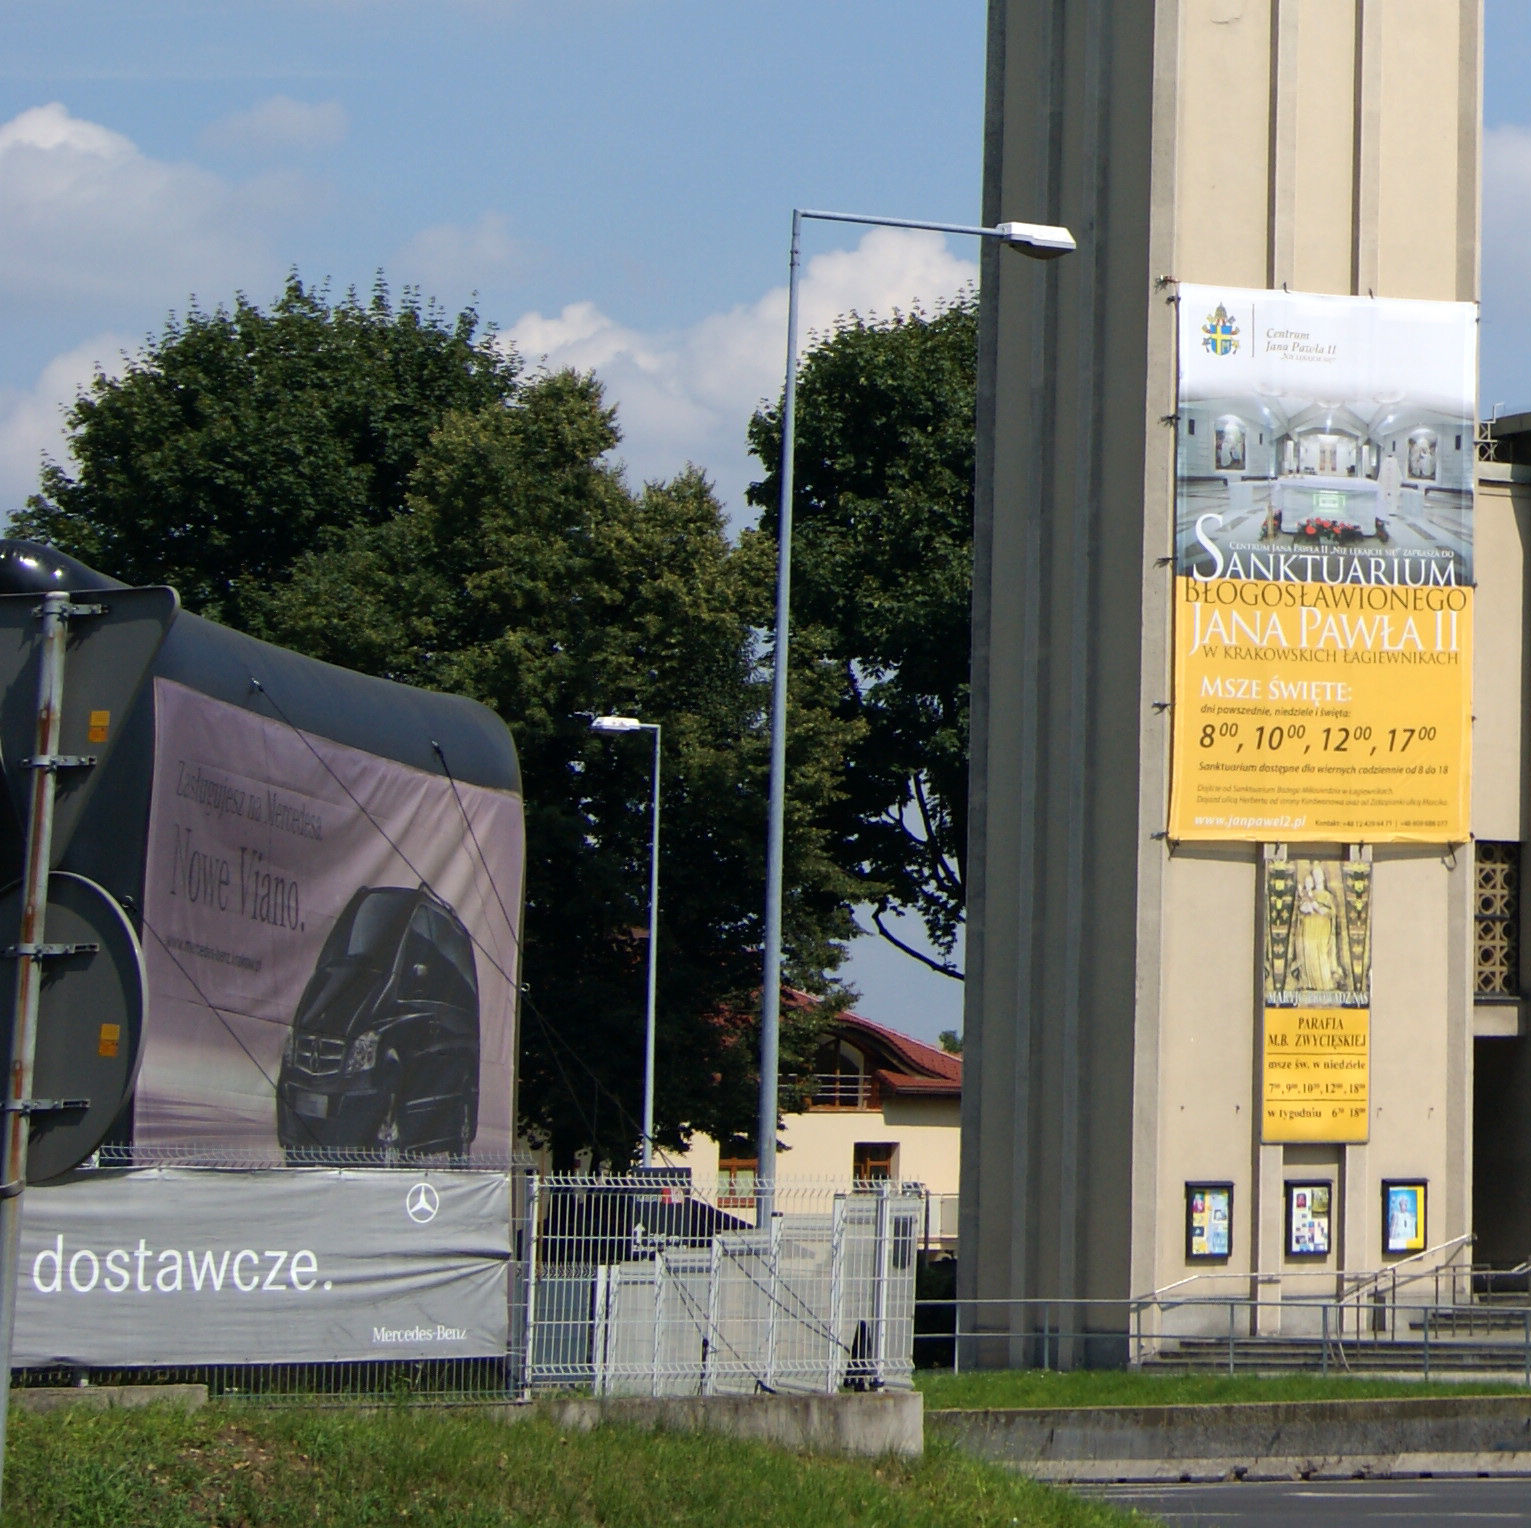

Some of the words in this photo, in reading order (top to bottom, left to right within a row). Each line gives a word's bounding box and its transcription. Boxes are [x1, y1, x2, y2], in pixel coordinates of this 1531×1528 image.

[1266, 327, 1310, 340] Centrum
[1265, 341, 1289, 352] Jana
[1192, 513, 1459, 588] SANKTUARIUM
[1184, 578, 1467, 612] BŁOGOSŁAWIONEGO
[1189, 602, 1289, 656] JANA
[1300, 606, 1423, 652] PAWŁA
[1434, 610, 1460, 652] II
[1203, 645, 1219, 658] W
[1224, 646, 1337, 663] KRAKOWSKICH
[1343, 649, 1459, 665] ŁAGIEWNIKACH
[1200, 674, 1262, 700] MSZE
[1268, 674, 1352, 708] ŚWIĘTE:
[1200, 704, 1216, 714] dni
[1217, 705, 1272, 717] powszednie,
[1274, 707, 1313, 717] niedziele
[1199, 761, 1257, 773] Sanktuarium
[1258, 763, 1300, 775] dostępne
[1405, 765, 1417, 775] od
[1418, 765, 1424, 775] 8
[1425, 766, 1437, 775] do
[248, 794, 262, 822] na
[169, 822, 231, 912] Nowe
[240, 845, 305, 932] Viano.
[1298, 1017, 1344, 1030] PARAFIA
[1269, 1034, 1289, 1047] M.B.
[1295, 1034, 1366, 1049] ZWYCIĘSKIEJ
[1268, 1061, 1292, 1070] msze
[1323, 1060, 1366, 1070] niedziele
[1279, 1108, 1322, 1120] tygodniu
[33, 1233, 334, 1293] dostawcze.
[372, 1323, 468, 1344] Mercedes-Benz
